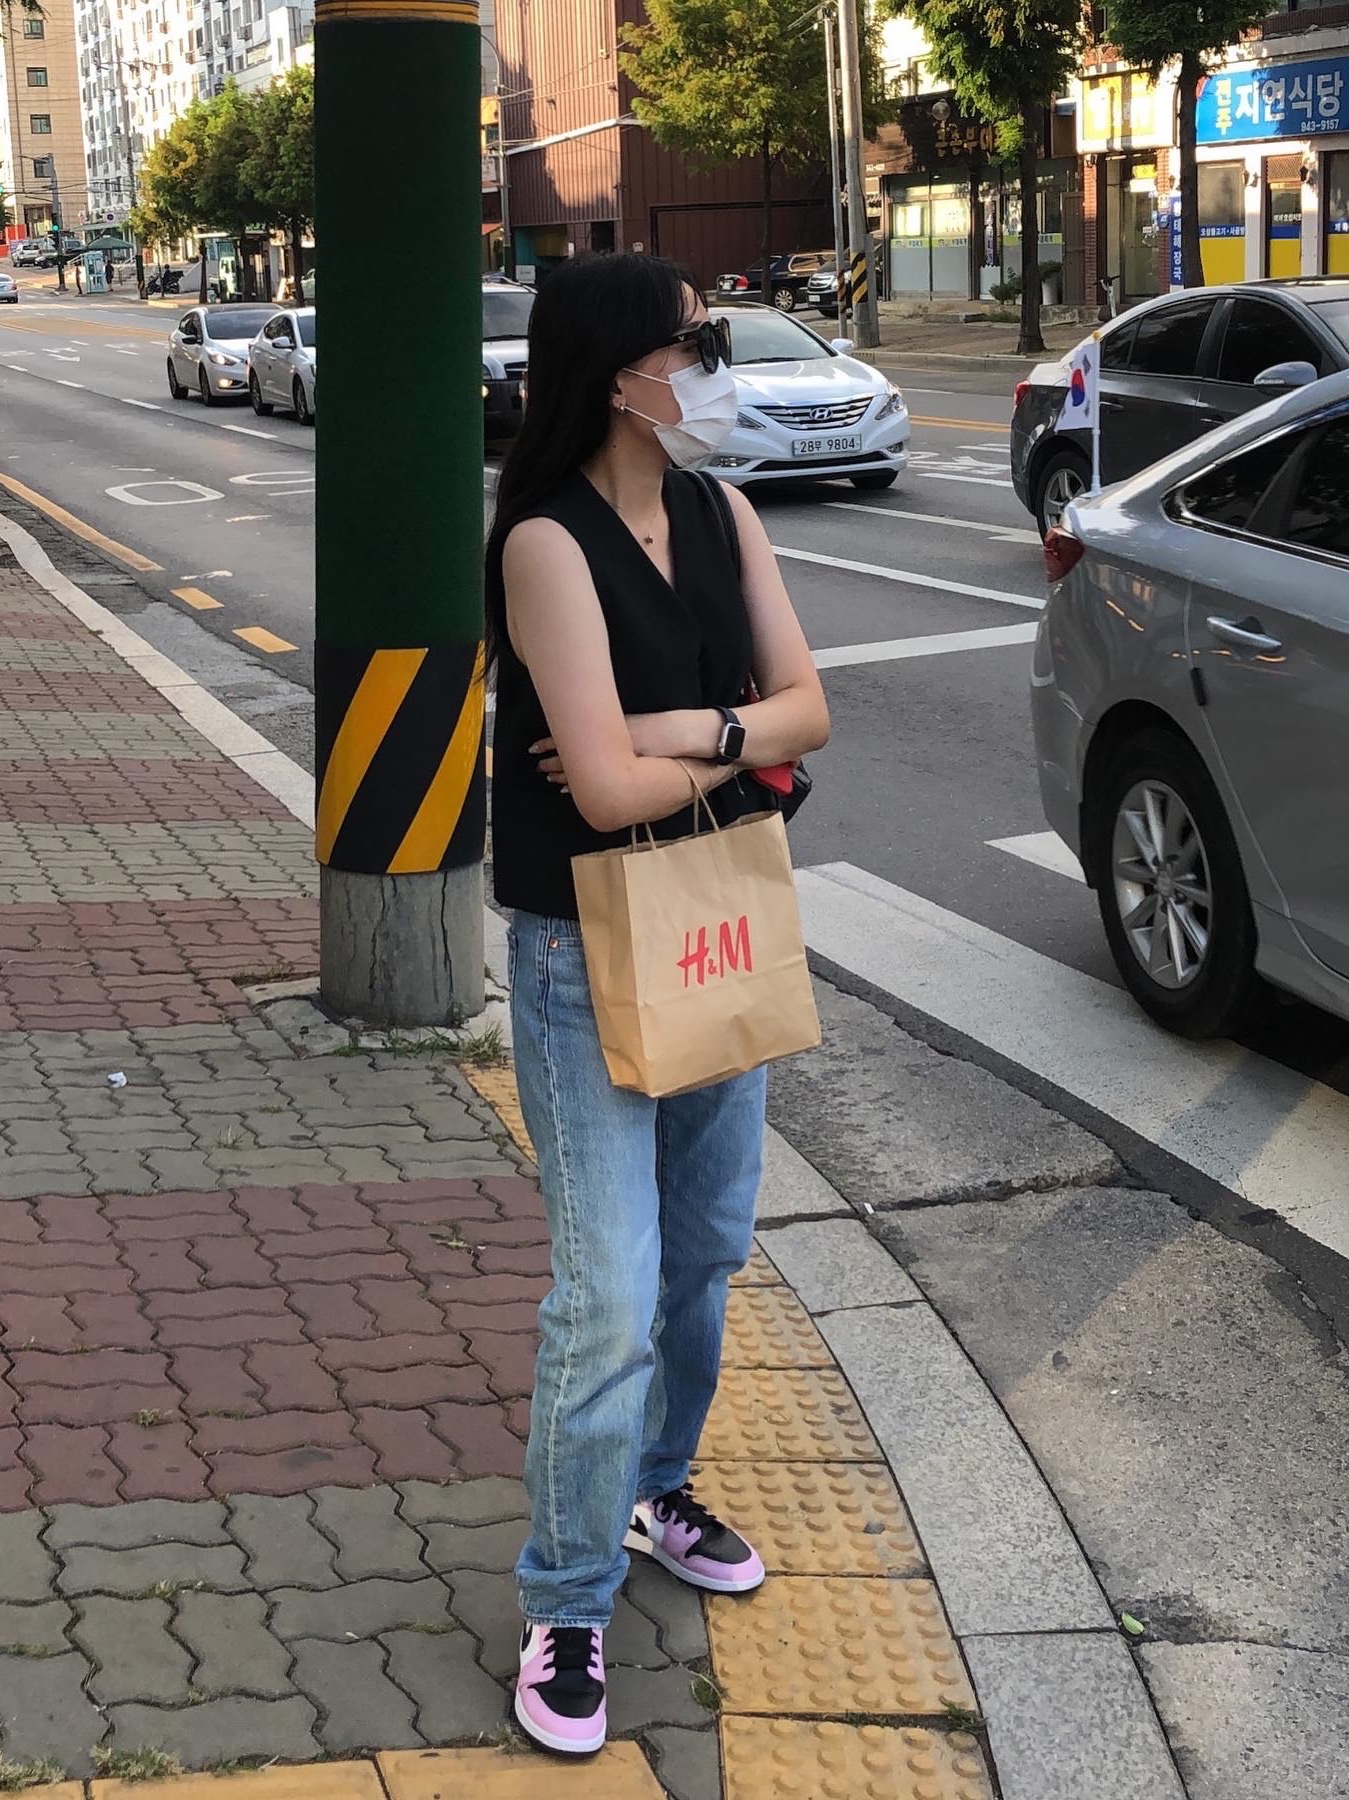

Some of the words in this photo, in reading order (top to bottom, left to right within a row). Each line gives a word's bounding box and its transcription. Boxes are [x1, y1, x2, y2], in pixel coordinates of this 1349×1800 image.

[1235, 71, 1344, 124] 지연식당
[1301, 119, 1340, 132] 943-9157
[827, 438, 855, 451] 9804
[676, 914, 753, 988] H&M
